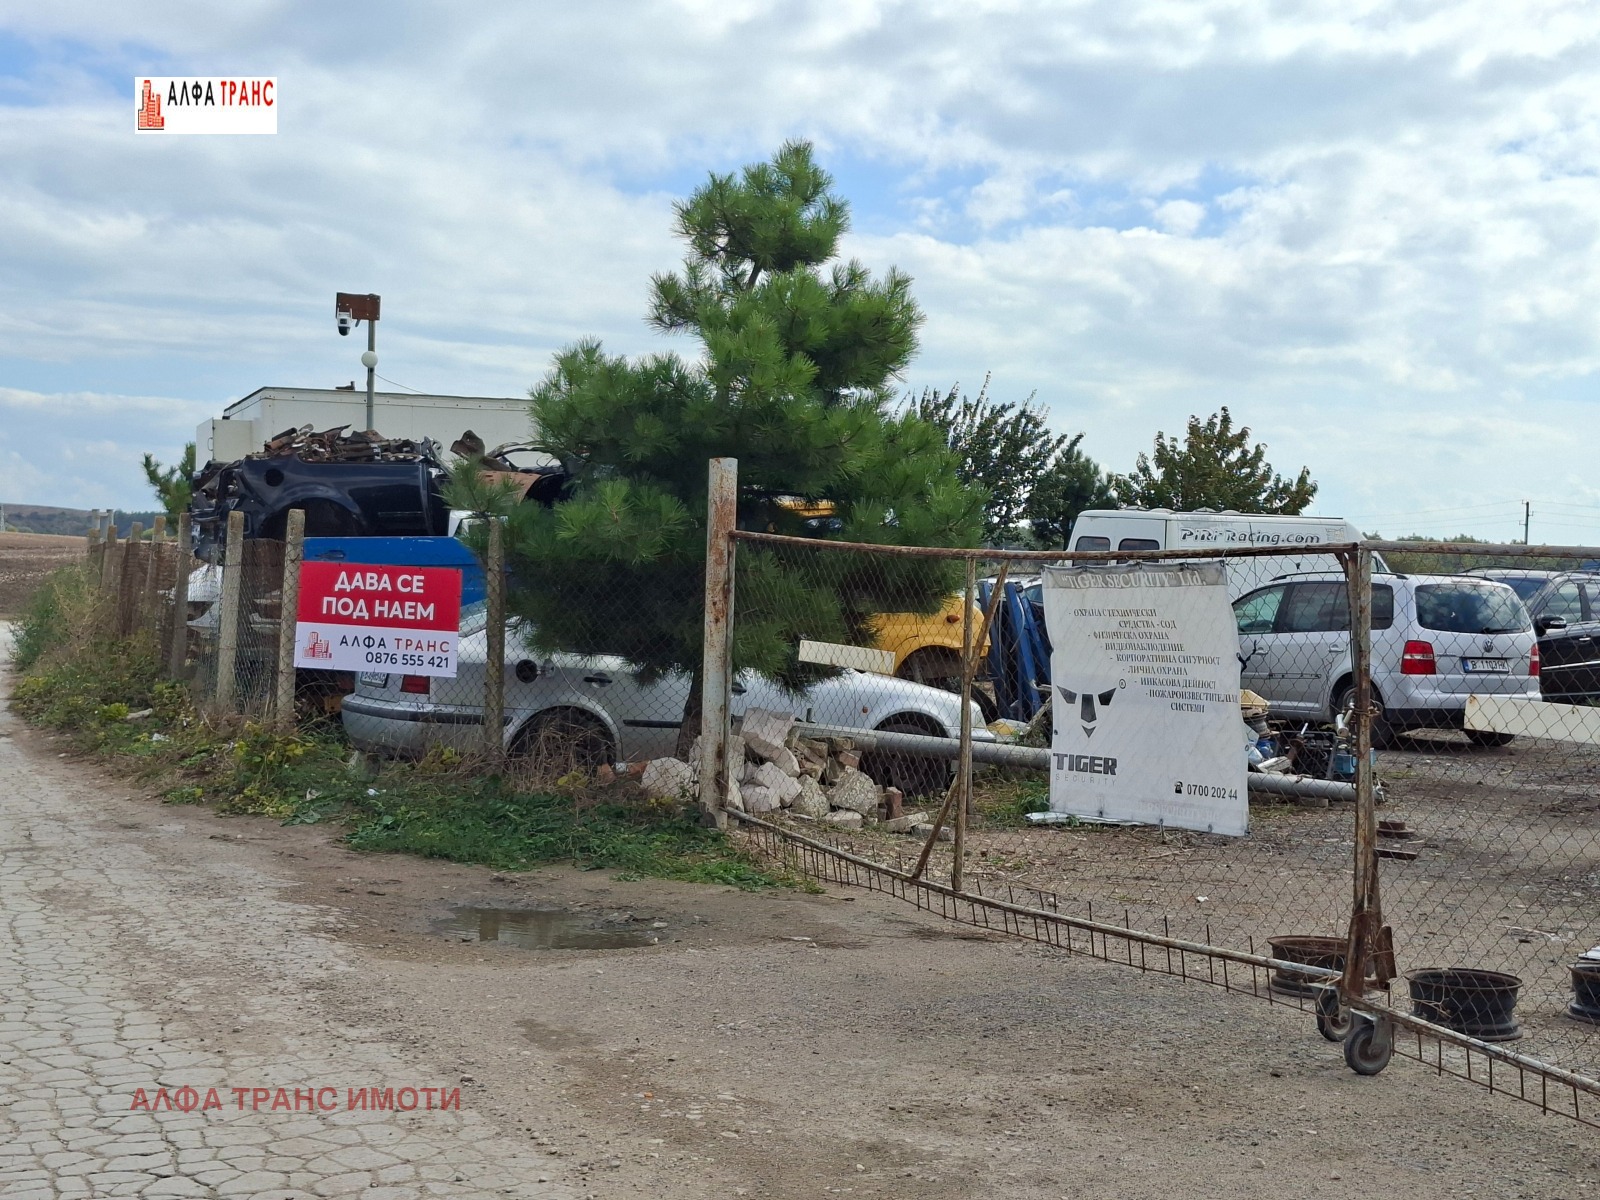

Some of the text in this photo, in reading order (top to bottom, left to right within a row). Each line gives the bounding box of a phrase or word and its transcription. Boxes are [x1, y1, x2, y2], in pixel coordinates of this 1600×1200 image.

[334, 571, 425, 593] ДАВА СЕ
[322, 597, 435, 621] ПОД НАЕМ
[339, 634, 450, 653] АЛФА ТРАНС
[1138, 631, 1170, 640] ОХРАНА
[366, 652, 449, 668] 0876 555 421
[1128, 665, 1188, 676] ЛИЧНА ОХРАНА
[1170, 702, 1205, 713] СИСТЕМИ
[1053, 753, 1117, 776] TIGER
[1055, 773, 1117, 787] SECURITY
[1186, 783, 1238, 800] 0700 202 44
